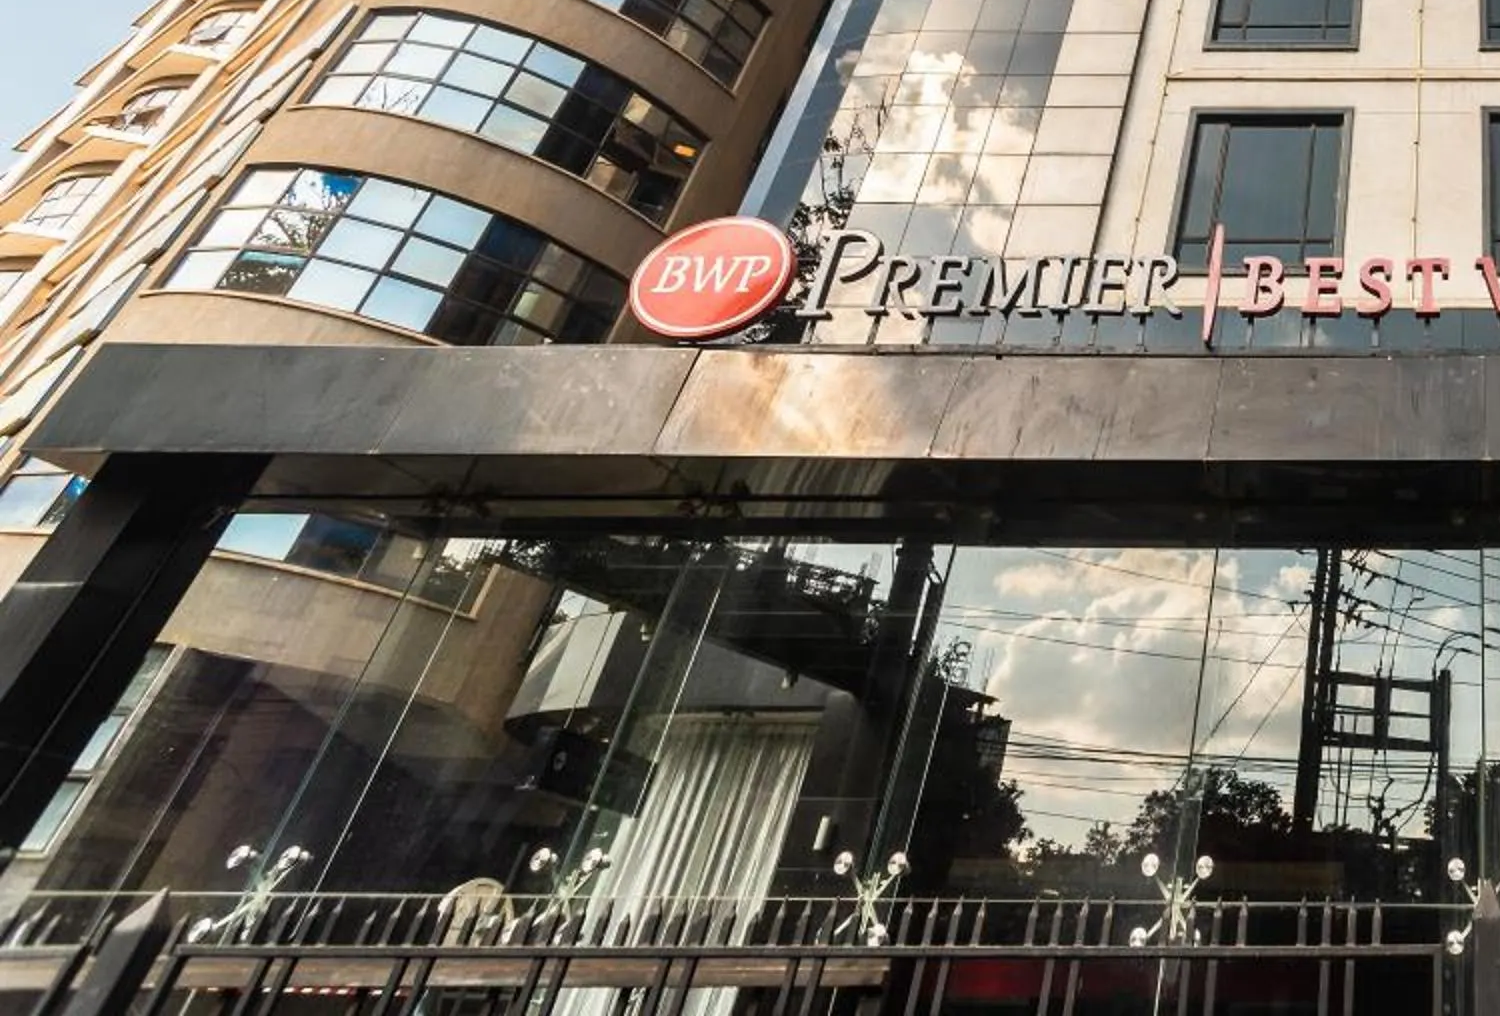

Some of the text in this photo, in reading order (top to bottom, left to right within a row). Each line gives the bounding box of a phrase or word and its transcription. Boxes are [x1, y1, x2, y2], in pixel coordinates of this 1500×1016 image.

[651, 254, 772, 294] BWP
[795, 228, 1181, 319] PREMIER
[1239, 255, 1449, 319] BEST
